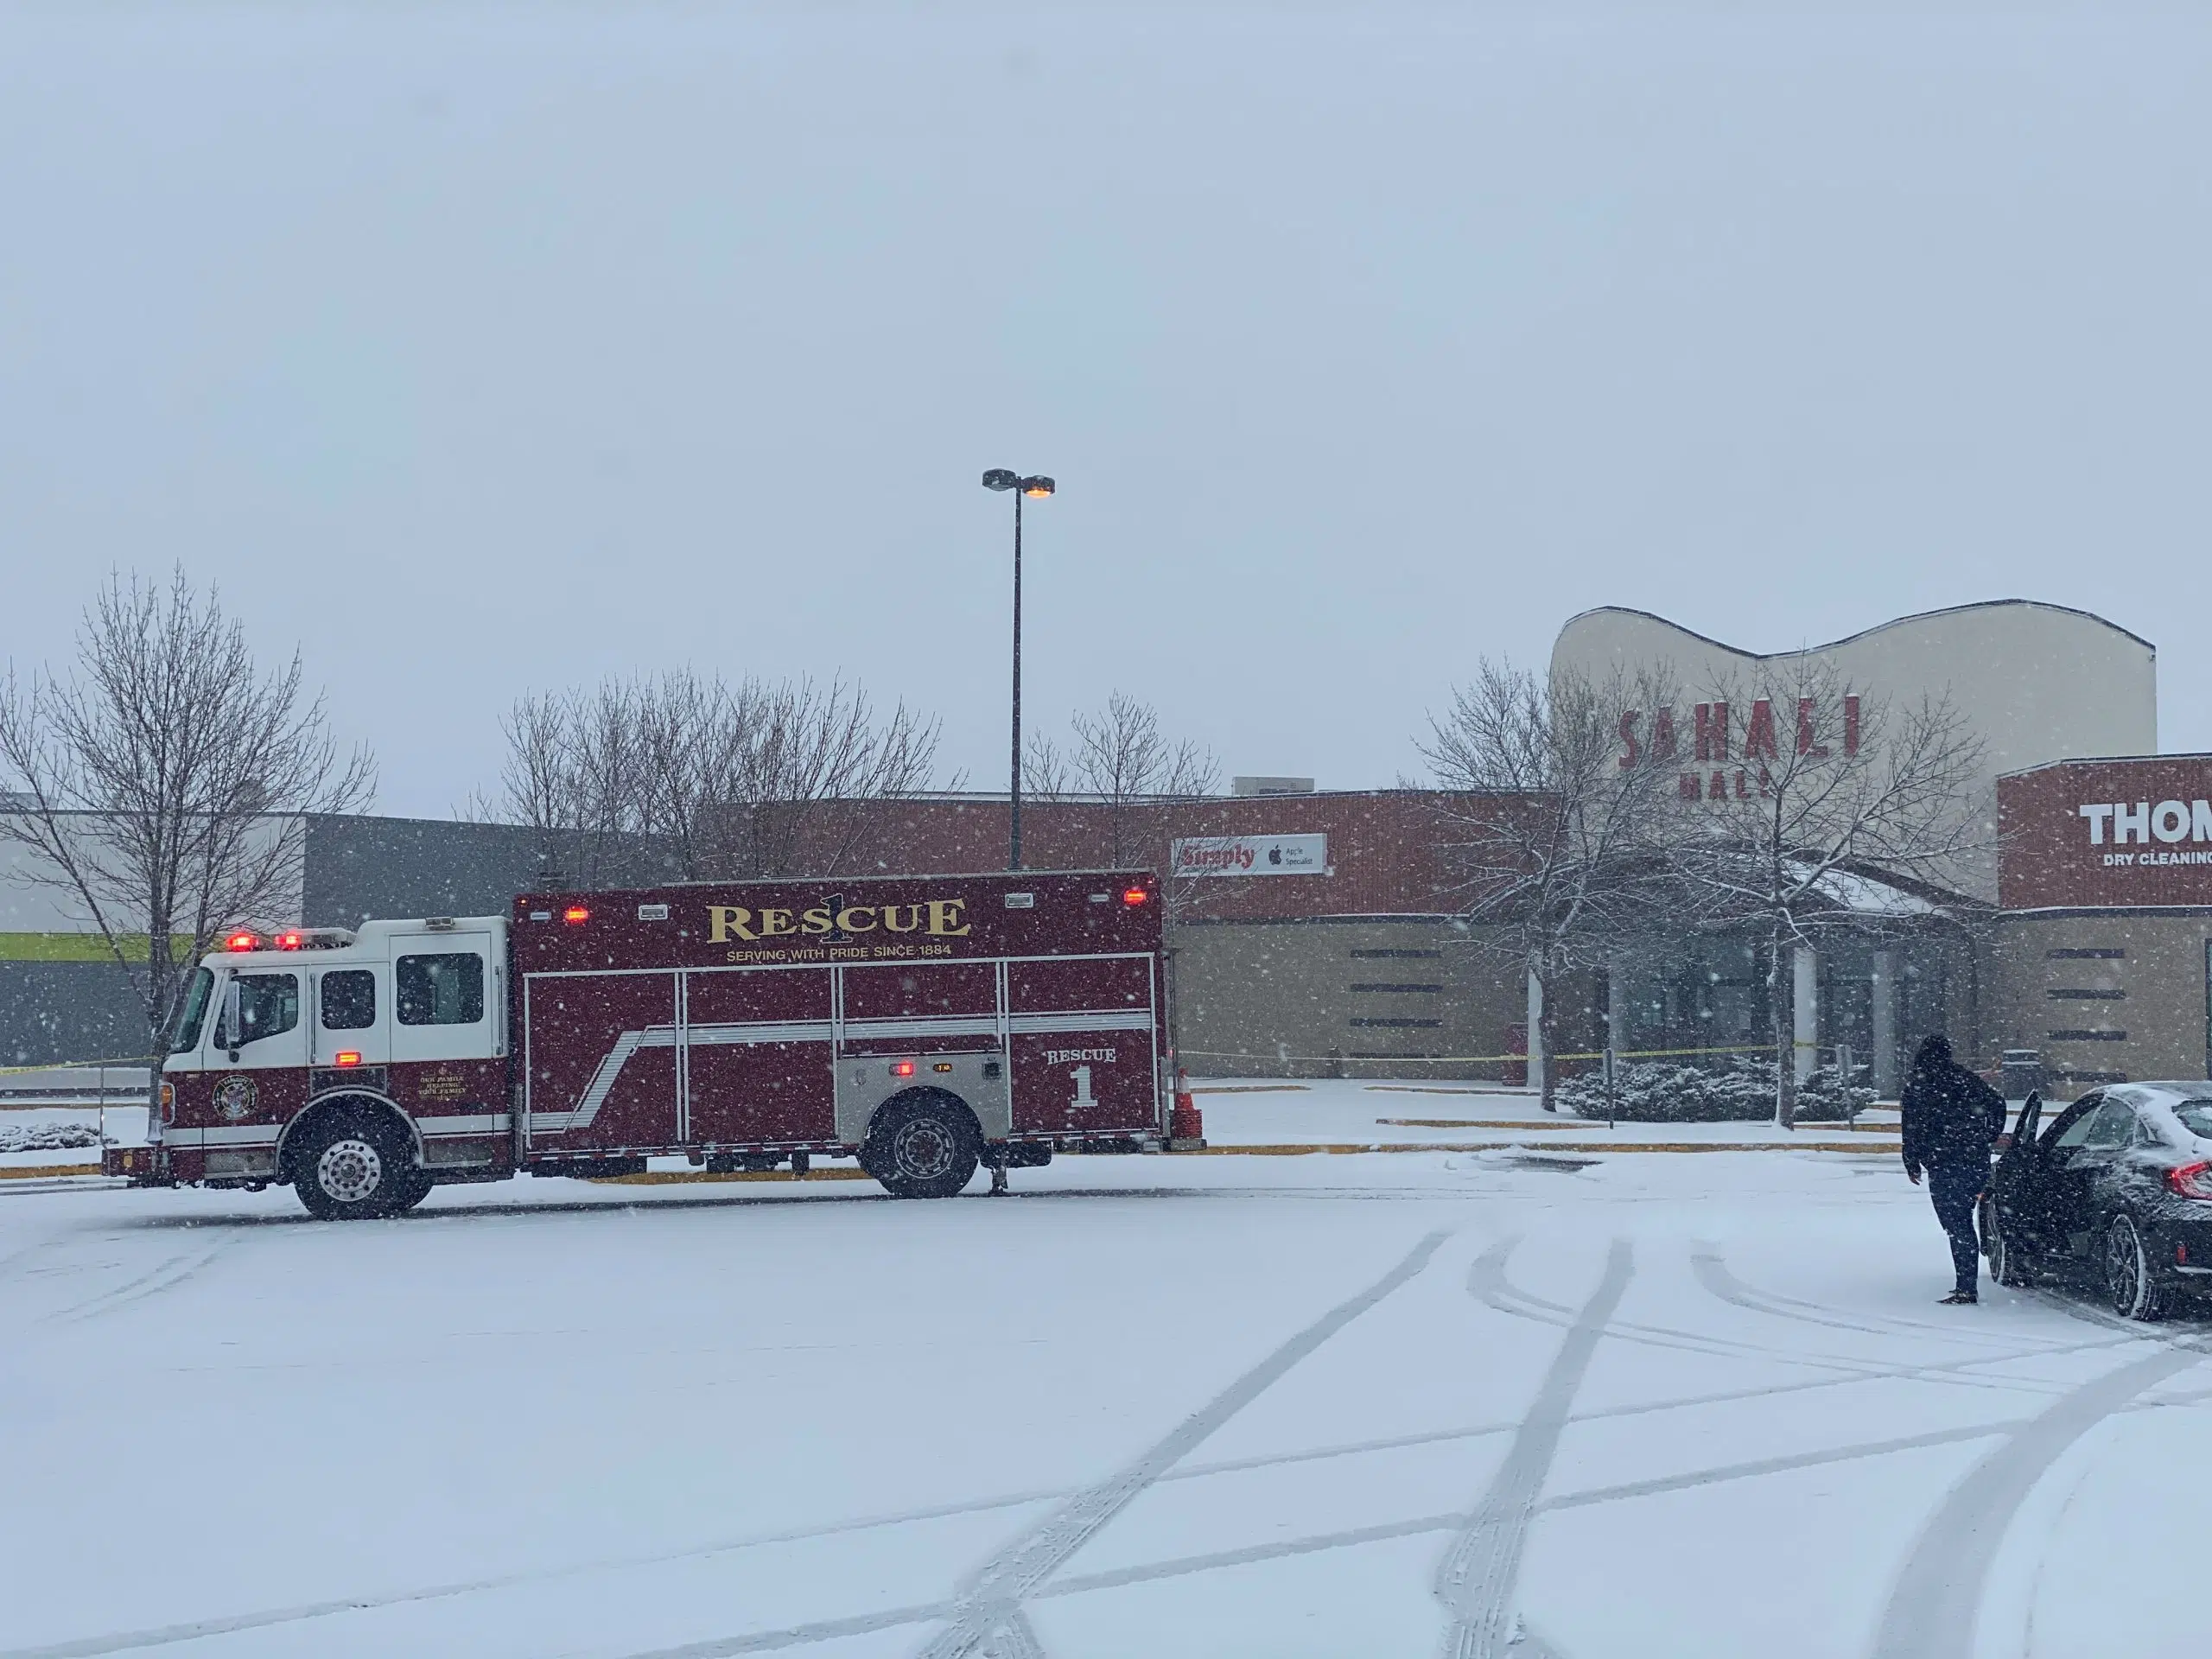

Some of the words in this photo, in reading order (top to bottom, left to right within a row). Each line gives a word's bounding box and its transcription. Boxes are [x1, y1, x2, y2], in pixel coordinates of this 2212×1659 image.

[1618, 692, 1859, 769] SAHALI
[1286, 847, 1304, 856] Apple
[2103, 853, 2135, 866] DRY
[1286, 857, 1313, 867] Specialist
[705, 898, 972, 944] RESCUE
[727, 950, 785, 962] SERVING
[791, 949, 824, 960] WITH
[830, 947, 868, 957] PRIDE
[874, 945, 915, 957] SINCE
[919, 944, 951, 955] 1884
[1046, 1048, 1116, 1065] RESCUE
[1070, 1065, 1098, 1107] 1
